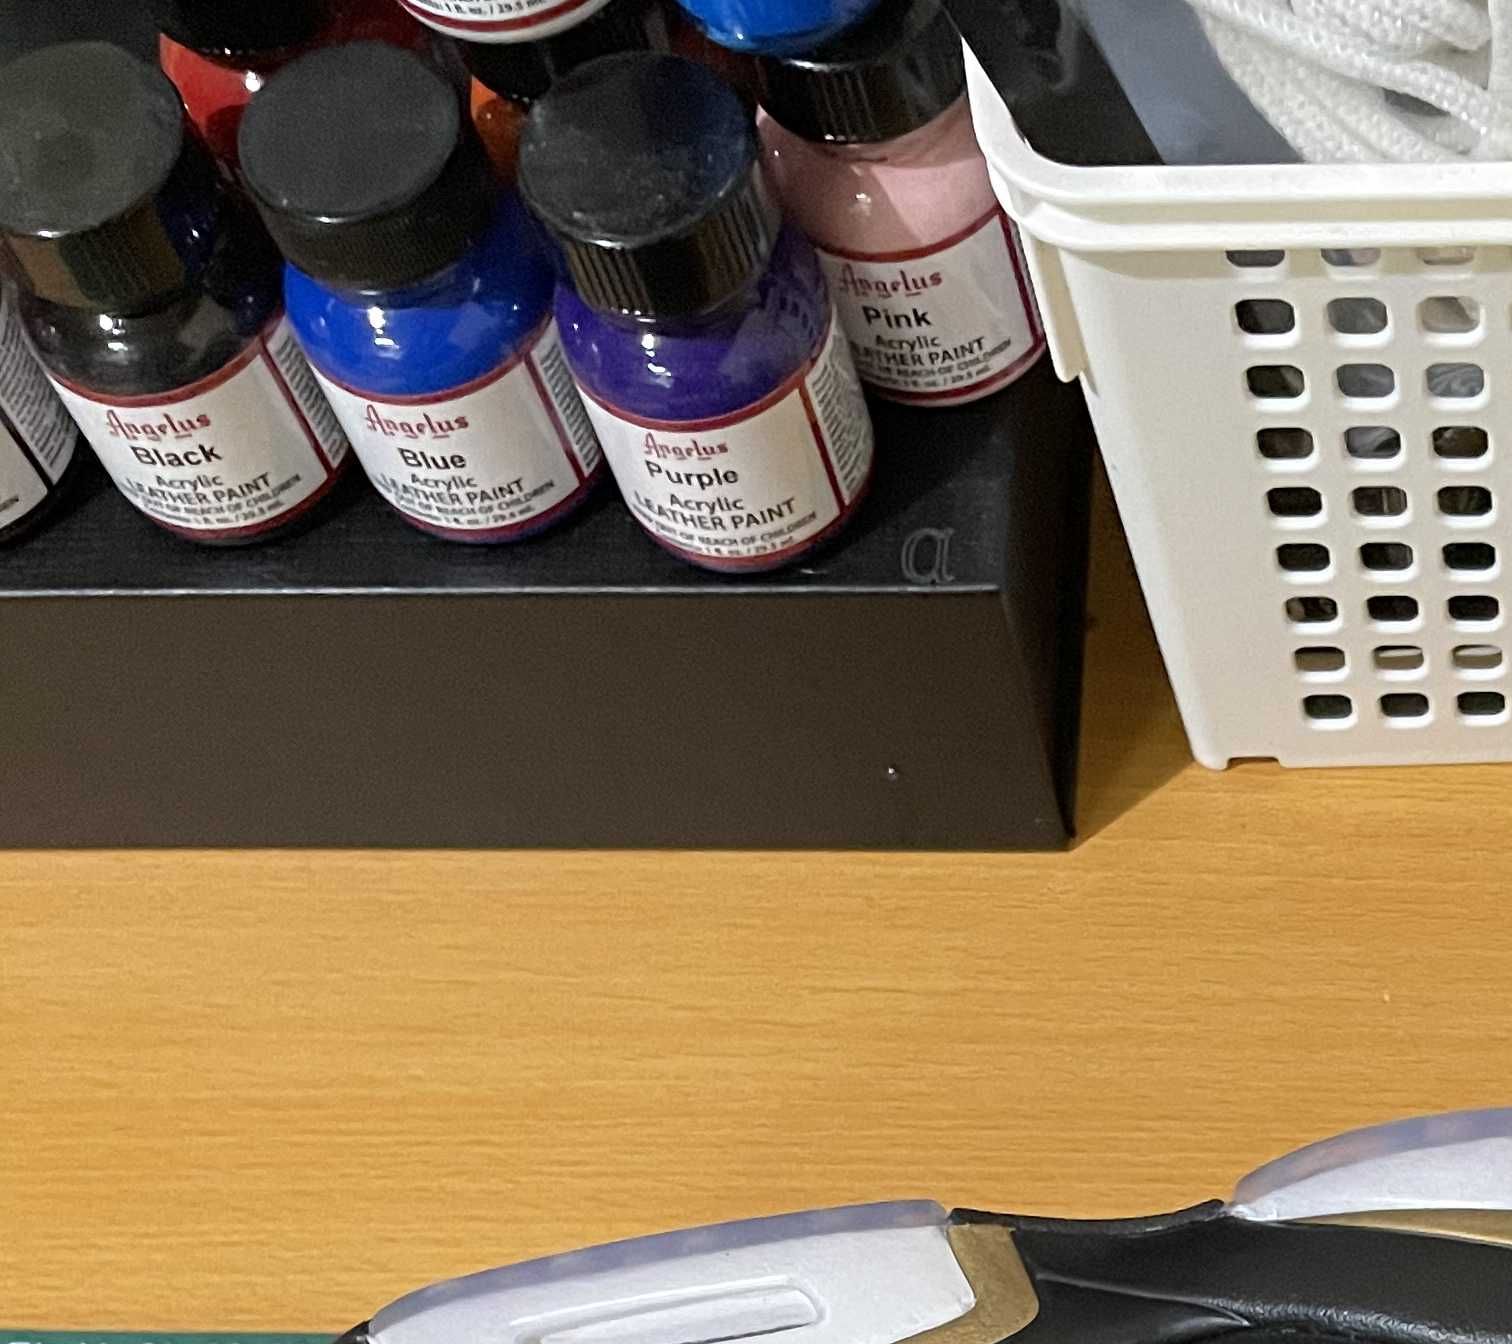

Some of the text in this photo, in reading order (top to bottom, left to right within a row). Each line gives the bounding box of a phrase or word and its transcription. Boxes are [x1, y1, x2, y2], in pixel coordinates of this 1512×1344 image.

[840, 264, 943, 298] Angelus
[862, 305, 932, 329] Pink
[875, 335, 940, 353] Acrylic
[928, 336, 985, 366] PAINT
[106, 409, 211, 441] Angelus
[366, 404, 470, 439] Angelus
[130, 443, 223, 467] Black
[398, 447, 467, 470] Blue
[643, 432, 729, 461] Angelus
[155, 474, 224, 492] Acrylic
[213, 472, 271, 503] PAINT
[411, 473, 478, 492] Acrylic
[645, 459, 739, 491] Purple
[466, 478, 524, 506] PAINT
[670, 493, 745, 514] Acrylic
[634, 490, 727, 531] LEATHER
[731, 497, 796, 530] PAINT
